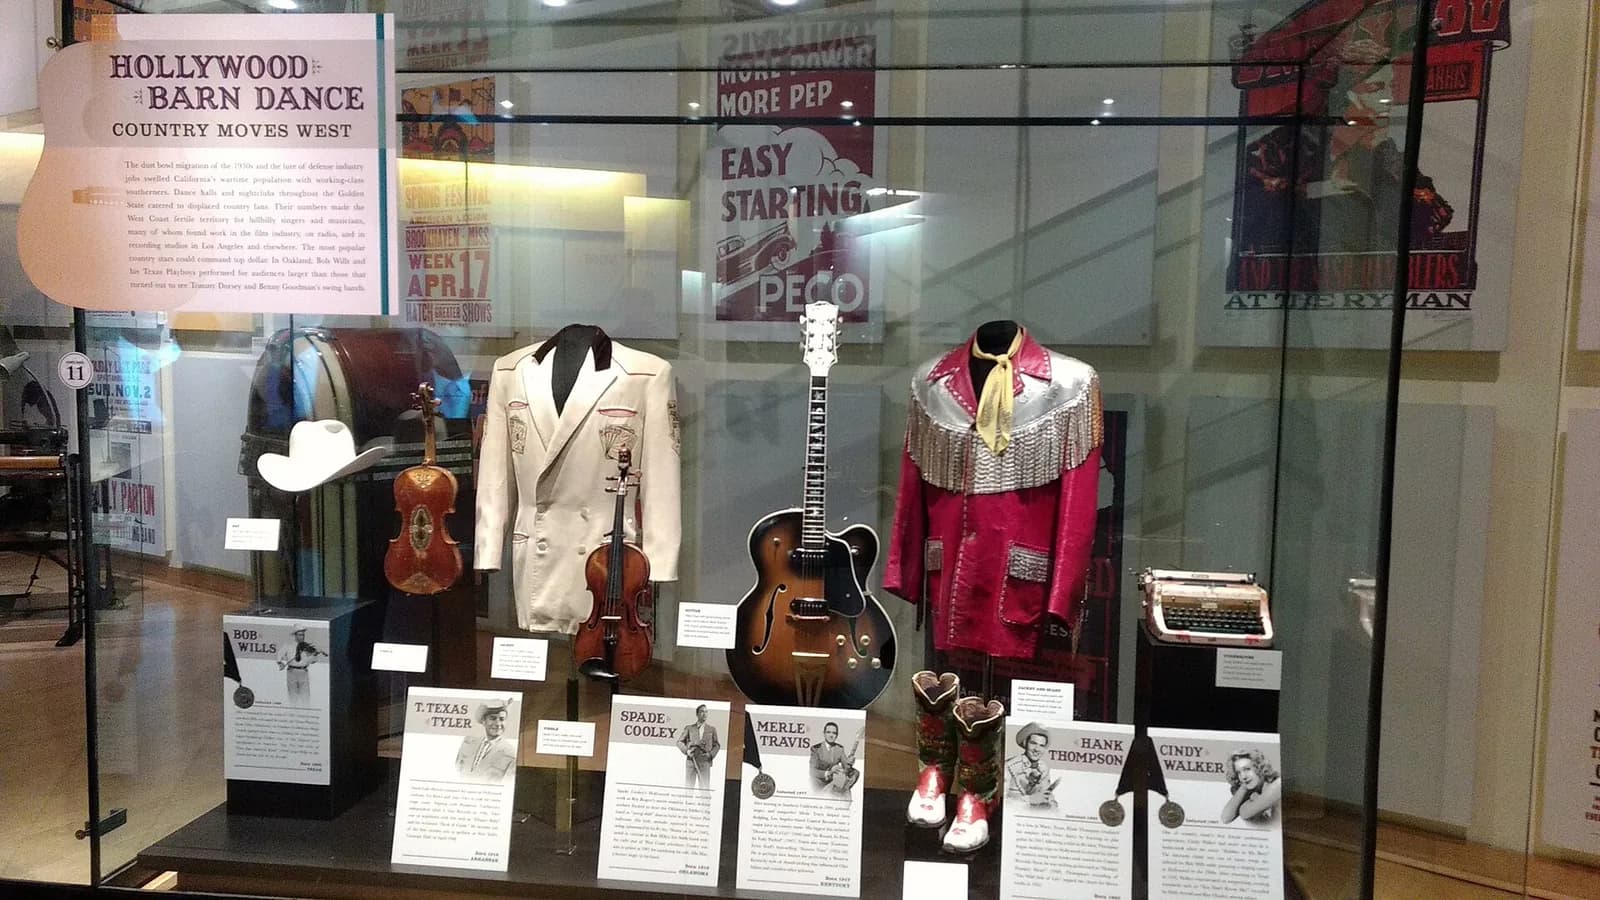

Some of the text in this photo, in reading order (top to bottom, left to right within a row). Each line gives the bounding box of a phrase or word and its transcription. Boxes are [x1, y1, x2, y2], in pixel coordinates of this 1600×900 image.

[109, 54, 309, 80] HOLLYWOOD
[719, 55, 782, 85] MORE
[147, 86, 364, 110] BARN DANCE
[720, 80, 834, 117] MORE PEP
[112, 123, 352, 138] COUNTRY MOVES WEST
[125, 161, 138, 169] The
[140, 161, 155, 169] dust
[157, 161, 174, 169] bowl
[176, 161, 208, 171] migration
[210, 161, 218, 169] of
[220, 161, 230, 169] the
[256, 161, 268, 169] and
[270, 161, 280, 169] the
[308, 162, 334, 170] defense
[336, 162, 364, 172] industry
[721, 142, 793, 181] EASY
[174, 175, 216, 183] California's
[220, 175, 248, 183] wartime
[252, 176, 292, 185] population
[316, 176, 364, 185] working-class
[174, 188, 196, 196] Dance
[279, 189, 318, 198] throughout
[338, 189, 364, 197] Golden
[188, 202, 220, 211] displaced
[224, 203, 250, 211] country
[720, 180, 863, 223] STARTING
[200, 216, 229, 225] territory
[250, 216, 276, 225] hillbilly
[280, 216, 305, 225] singers
[310, 216, 324, 224] and
[128, 230, 147, 238] many
[405, 228, 460, 249] BROOKHAVEN
[128, 242, 161, 251] recording
[217, 243, 244, 252] Angeles
[338, 245, 366, 253] popular
[128, 256, 154, 264] country
[407, 252, 455, 270] WEEK
[166, 269, 196, 277] Playboys
[198, 269, 235, 278] performed
[288, 270, 308, 278] larger
[459, 250, 490, 298] 17
[218, 283, 241, 292] Dorsey
[322, 284, 342, 293] swing
[407, 273, 457, 297] APR
[758, 271, 865, 314] PECO
[1225, 293, 1268, 309] AT
[405, 302, 433, 323] HATCH
[462, 302, 493, 323] SHOWS
[66, 365, 84, 382] 11
[120, 481, 155, 517] PARTON
[233, 629, 258, 640] BOB
[238, 641, 277, 654] WILLS
[414, 702, 468, 715] T. TEXAS
[431, 716, 472, 729] TYLER
[620, 710, 666, 725] SPADE
[624, 724, 678, 739] COOLEY
[756, 720, 806, 735] MERLE
[759, 735, 811, 749] TRAVIS
[1080, 737, 1124, 752] HANK
[1049, 749, 1124, 766] THOMPSON
[1159, 744, 1204, 758] CINDY
[1163, 759, 1225, 774] WALKER
